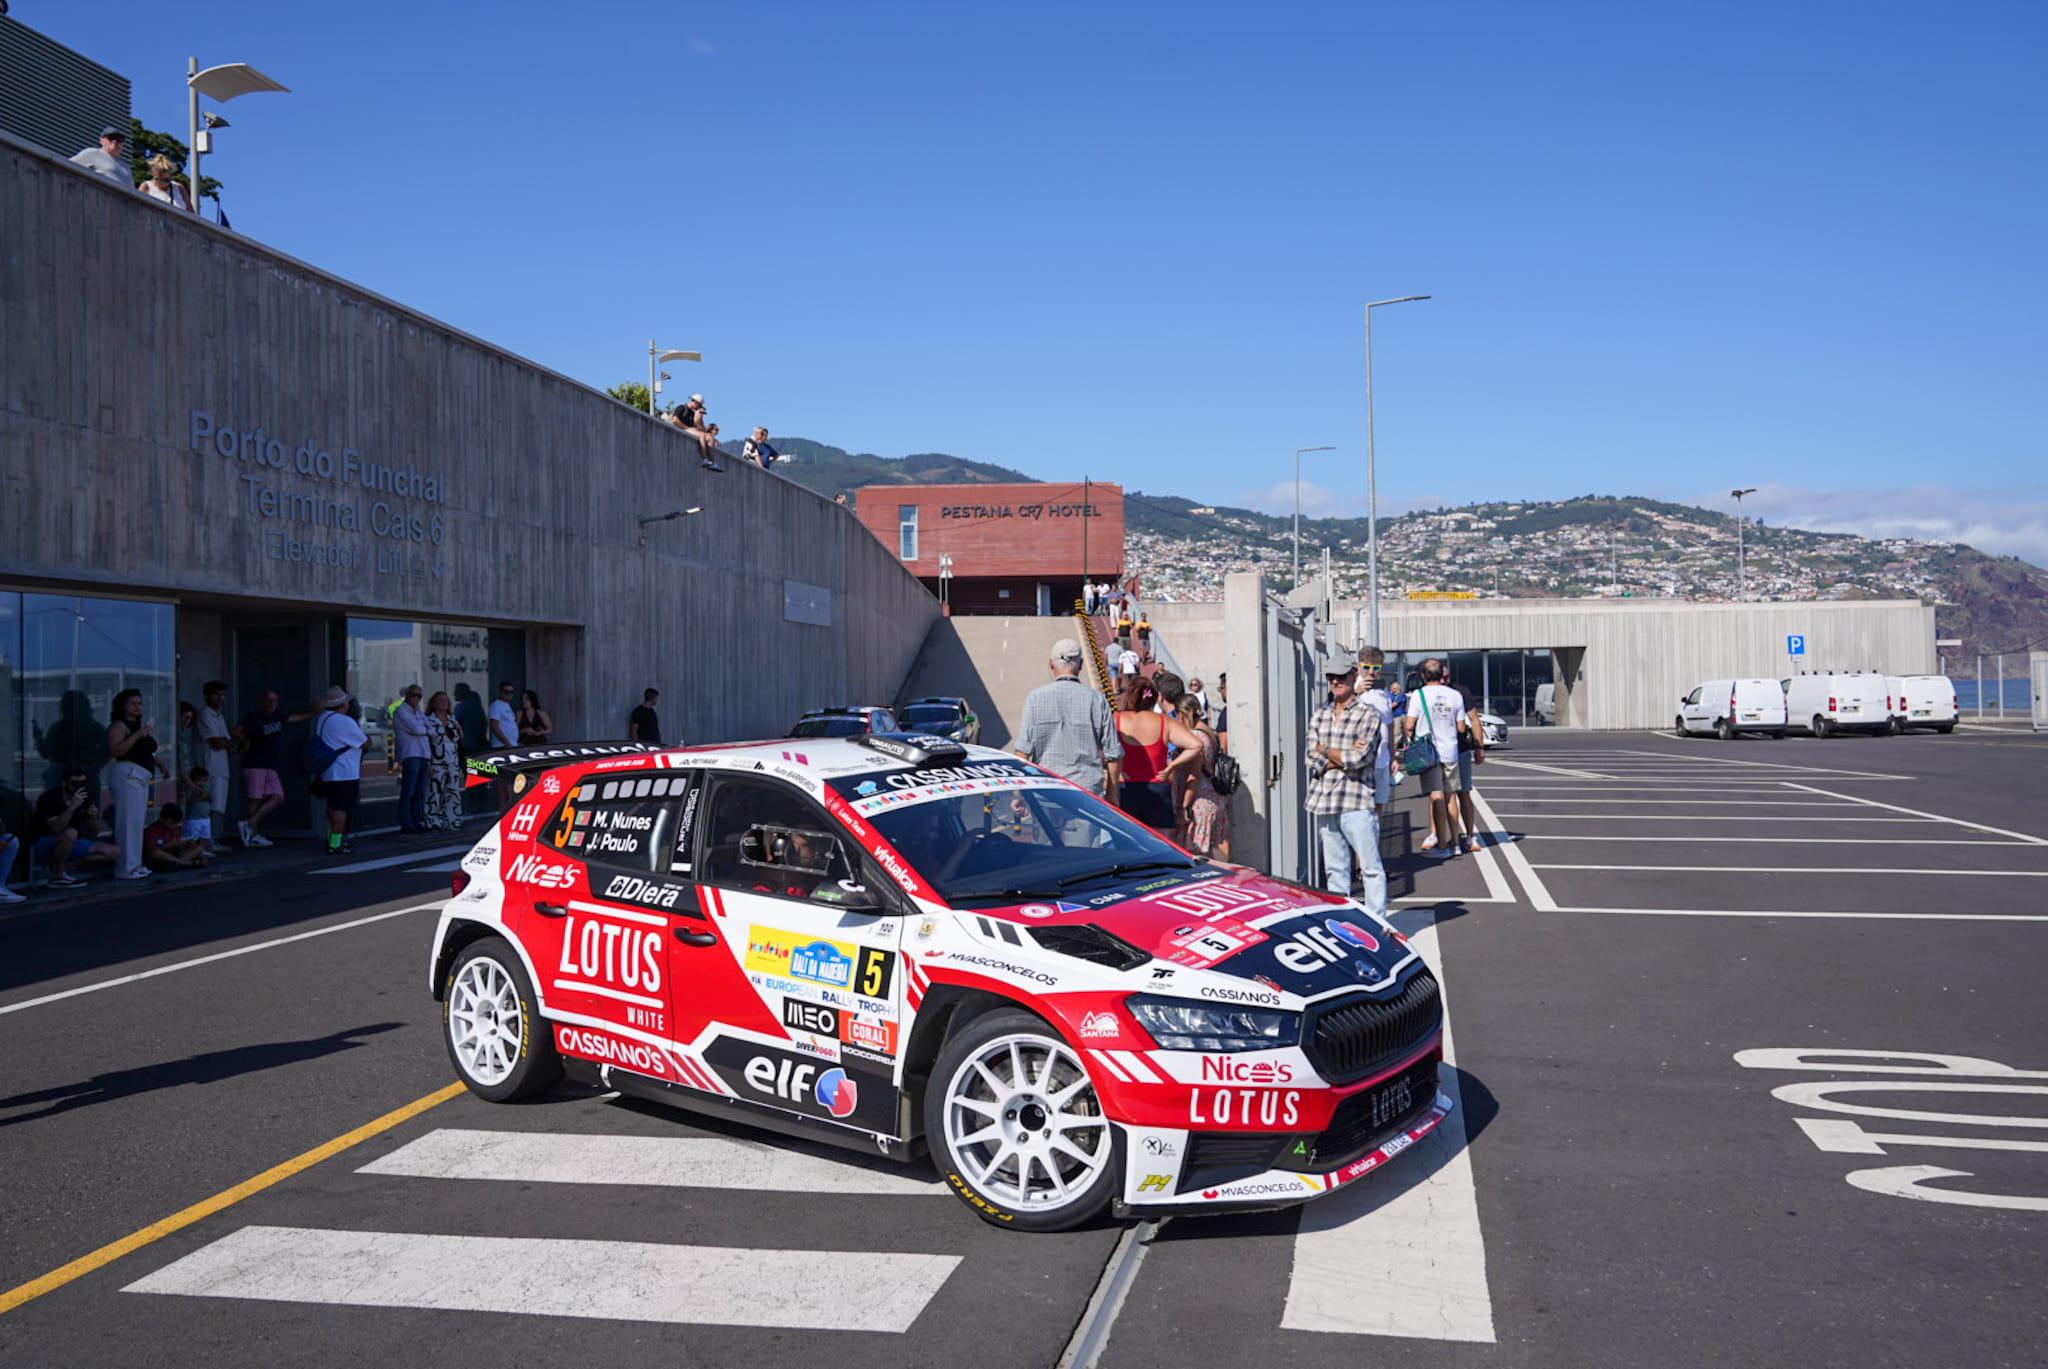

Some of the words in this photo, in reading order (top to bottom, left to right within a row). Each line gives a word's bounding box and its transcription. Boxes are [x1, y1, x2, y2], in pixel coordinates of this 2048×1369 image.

[190, 410, 286, 469] Porto
[295, 439, 335, 478] do
[342, 448, 446, 504] Funchal
[241, 474, 361, 533] Terminal
[371, 502, 424, 544] Cais
[430, 512, 446, 546] 6
[941, 505, 1013, 519] PESTANA
[1018, 503, 1043, 520] CR7
[1048, 504, 1102, 517] HOTEL
[265, 528, 359, 570] Elevador
[1790, 636, 1802, 653] P
[885, 762, 1024, 791] CASSIANO'S
[555, 786, 583, 849] 5
[592, 811, 609, 829] M.
[610, 813, 652, 831] Nunes
[586, 834, 598, 850] J.
[601, 833, 638, 853] Paulo
[874, 845, 919, 894] virtualcar
[1156, 883, 1269, 917] LOTUS
[559, 916, 663, 993] LOTUS
[1201, 937, 1230, 951] 5
[1274, 926, 1349, 973] elf
[863, 951, 886, 997] 5
[948, 952, 1059, 986] MVASCONCELOS
[766, 978, 818, 998] EUROPEAN
[822, 990, 854, 1007] RALLY
[857, 999, 896, 1016] TROPHY
[1200, 986, 1281, 1006] CASSIANO'S
[627, 1006, 665, 1031] WHITE
[787, 1002, 836, 1033] MEO
[852, 1019, 886, 1044] CORAL
[559, 1027, 665, 1074] CASSIANO'S
[795, 1041, 834, 1057] DIVERFOGO
[744, 1056, 816, 1102] elf
[1190, 1088, 1301, 1126] LOTUS
[1220, 1181, 1305, 1198] MVASCONCELOS
